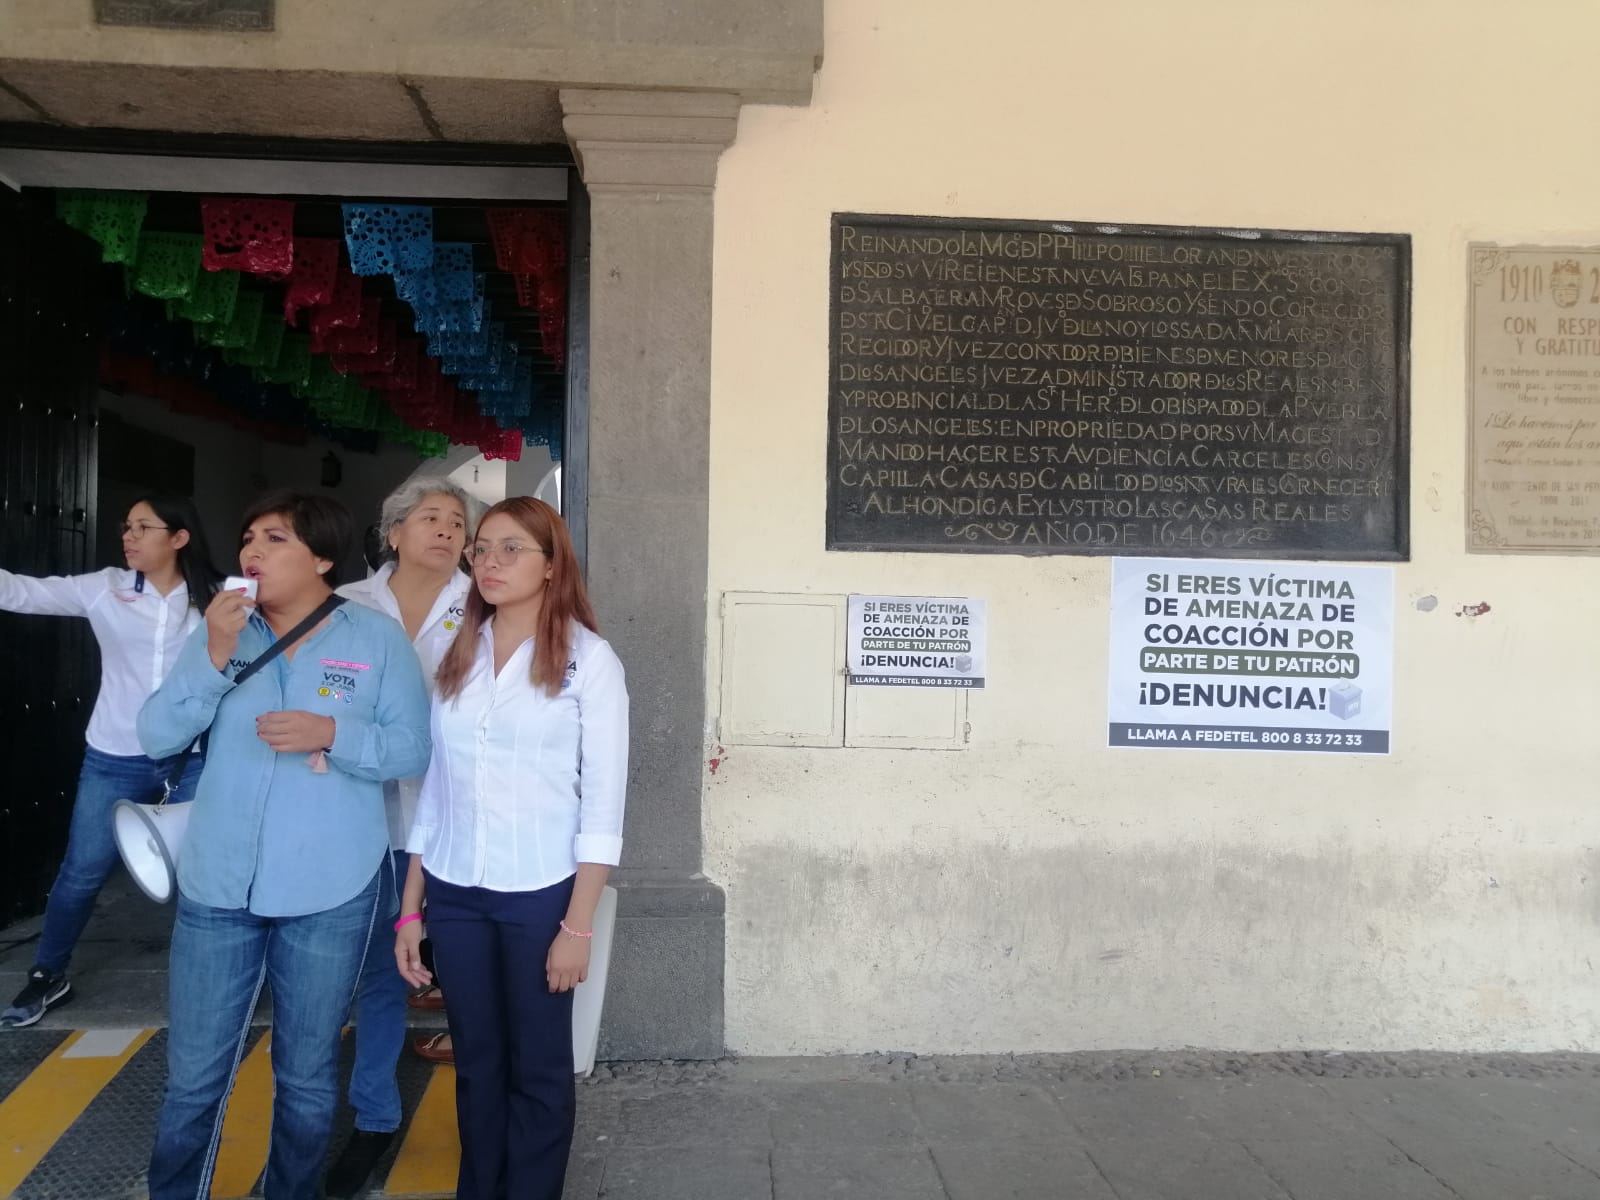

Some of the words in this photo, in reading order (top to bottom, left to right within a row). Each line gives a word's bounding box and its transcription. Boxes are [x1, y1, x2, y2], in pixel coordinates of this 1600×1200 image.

[1499, 264, 1543, 303] 1910
[1503, 316, 1537, 335] CON
[1558, 317, 1600, 336] RESP
[1146, 573, 1169, 593] SI
[1177, 574, 1241, 595] ERES
[1249, 573, 1355, 600] VÍCTIMA
[864, 602, 875, 611] SI
[879, 603, 912, 613] ERES
[915, 602, 969, 614] VÍCTIMA
[1144, 597, 1178, 616] DE
[1185, 598, 1314, 621] AMENAZA
[1322, 604, 1355, 622] DE
[863, 614, 880, 623] DE
[884, 614, 948, 625] AMENAZA
[952, 616, 969, 625] DE
[863, 625, 935, 638] COACCIÓN
[940, 629, 968, 639] POR
[1144, 622, 1289, 648] COACCIÓN
[1297, 628, 1354, 650] POR
[863, 640, 894, 649] PARTE
[897, 641, 910, 649] DE
[913, 642, 926, 650] TU
[929, 641, 969, 651] PATRÓN
[861, 655, 954, 668] ¡DENUNCIA!
[1144, 652, 1208, 670] PARTE
[1213, 655, 1239, 671] DE
[1244, 656, 1270, 671] TU
[1275, 655, 1354, 674] PATRÓN
[324, 672, 356, 688] VOTA
[1139, 682, 1327, 710] ¡DENUNCIA!
[1127, 728, 1178, 741] LLAMA
[1181, 730, 1192, 741] A
[1196, 730, 1258, 743] FEDETEL
[1261, 732, 1290, 744] 800
[1293, 733, 1302, 744] 8
[1305, 733, 1322, 745] 33
[1326, 734, 1342, 745] 72
[1345, 735, 1362, 746] 33
